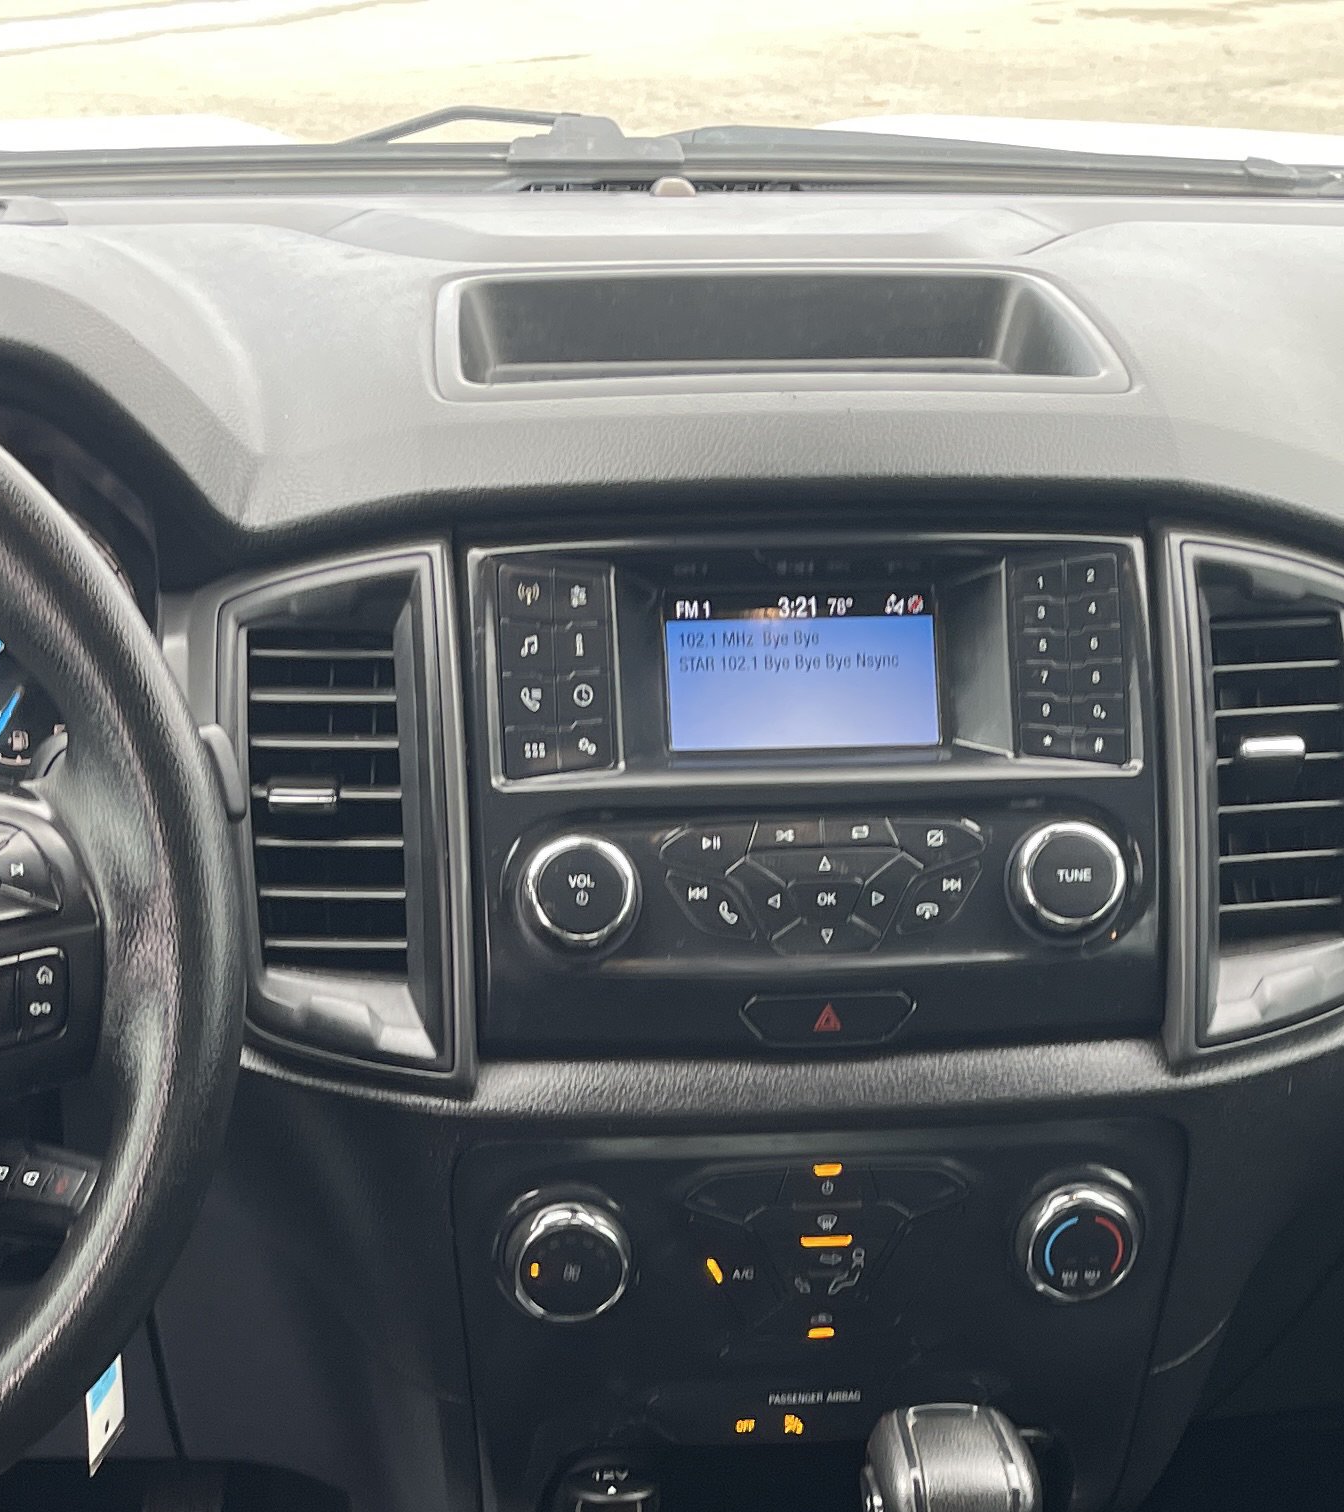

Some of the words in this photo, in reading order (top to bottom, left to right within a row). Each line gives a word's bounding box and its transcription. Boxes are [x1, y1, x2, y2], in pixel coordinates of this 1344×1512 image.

[1036, 575, 1044, 590] 1
[1086, 567, 1095, 583] 2
[675, 600, 699, 619] FM
[702, 599, 711, 619] 1
[777, 595, 817, 618] 3:21
[679, 631, 716, 649] 102.1
[722, 631, 753, 648] MHz
[763, 629, 789, 649] Bye
[793, 629, 820, 649] Bye
[679, 655, 715, 673] STAR
[720, 654, 757, 672] 102.1
[764, 654, 790, 673] Bye
[795, 653, 821, 673] Bye
[825, 653, 851, 672] Bye
[856, 652, 899, 672] Nsync
[567, 873, 594, 890] VOL
[1056, 867, 1093, 883] TUNE
[816, 891, 837, 907] OK
[732, 1267, 754, 1280] A/C
[768, 1391, 823, 1406] PASSENGER
[827, 1390, 861, 1403] AIRBAG
